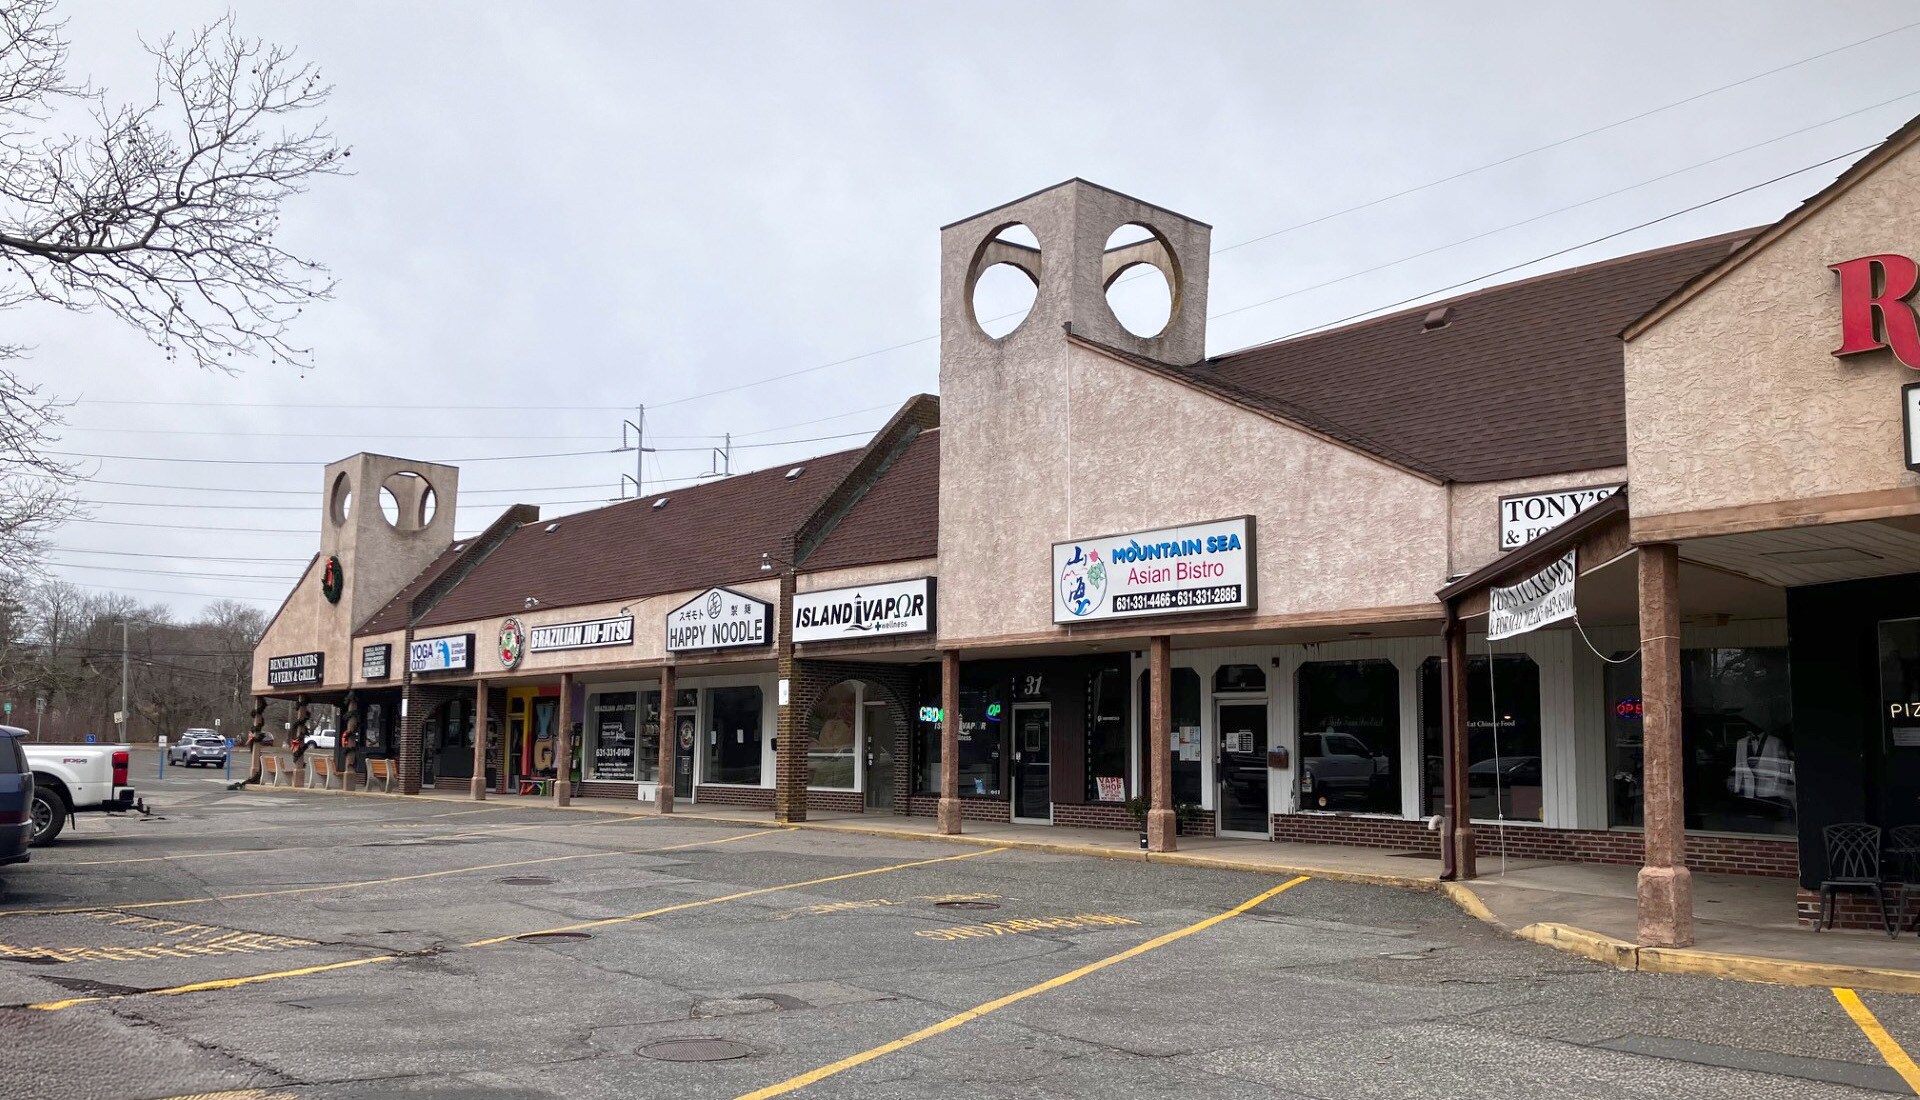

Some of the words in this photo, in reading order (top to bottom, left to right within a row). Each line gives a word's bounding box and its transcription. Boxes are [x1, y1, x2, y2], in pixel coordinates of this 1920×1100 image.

[1505, 530, 1520, 544] &
[1526, 526, 1556, 542] FO
[1112, 539, 1201, 564] MOUNTAIN
[1206, 534, 1241, 553] SEA
[1127, 566, 1171, 585] Asian
[1177, 561, 1224, 580] Bistro
[1117, 592, 1171, 610] 631-331-4466
[1177, 586, 1237, 606] 631-331-2886
[796, 603, 853, 628] ISLAND
[531, 626, 582, 648] BRAZILIAN
[583, 620, 632, 644] JIU-JITSU
[670, 625, 706, 648] HAPPY
[713, 619, 762, 644] NOODLE
[270, 654, 318, 670] BENCHWARMERS
[412, 643, 433, 659] YOGA
[270, 671, 293, 684] TAVERN
[298, 668, 316, 681] GRILL
[1024, 675, 1042, 695] 31
[920, 706, 938, 722] CBD
